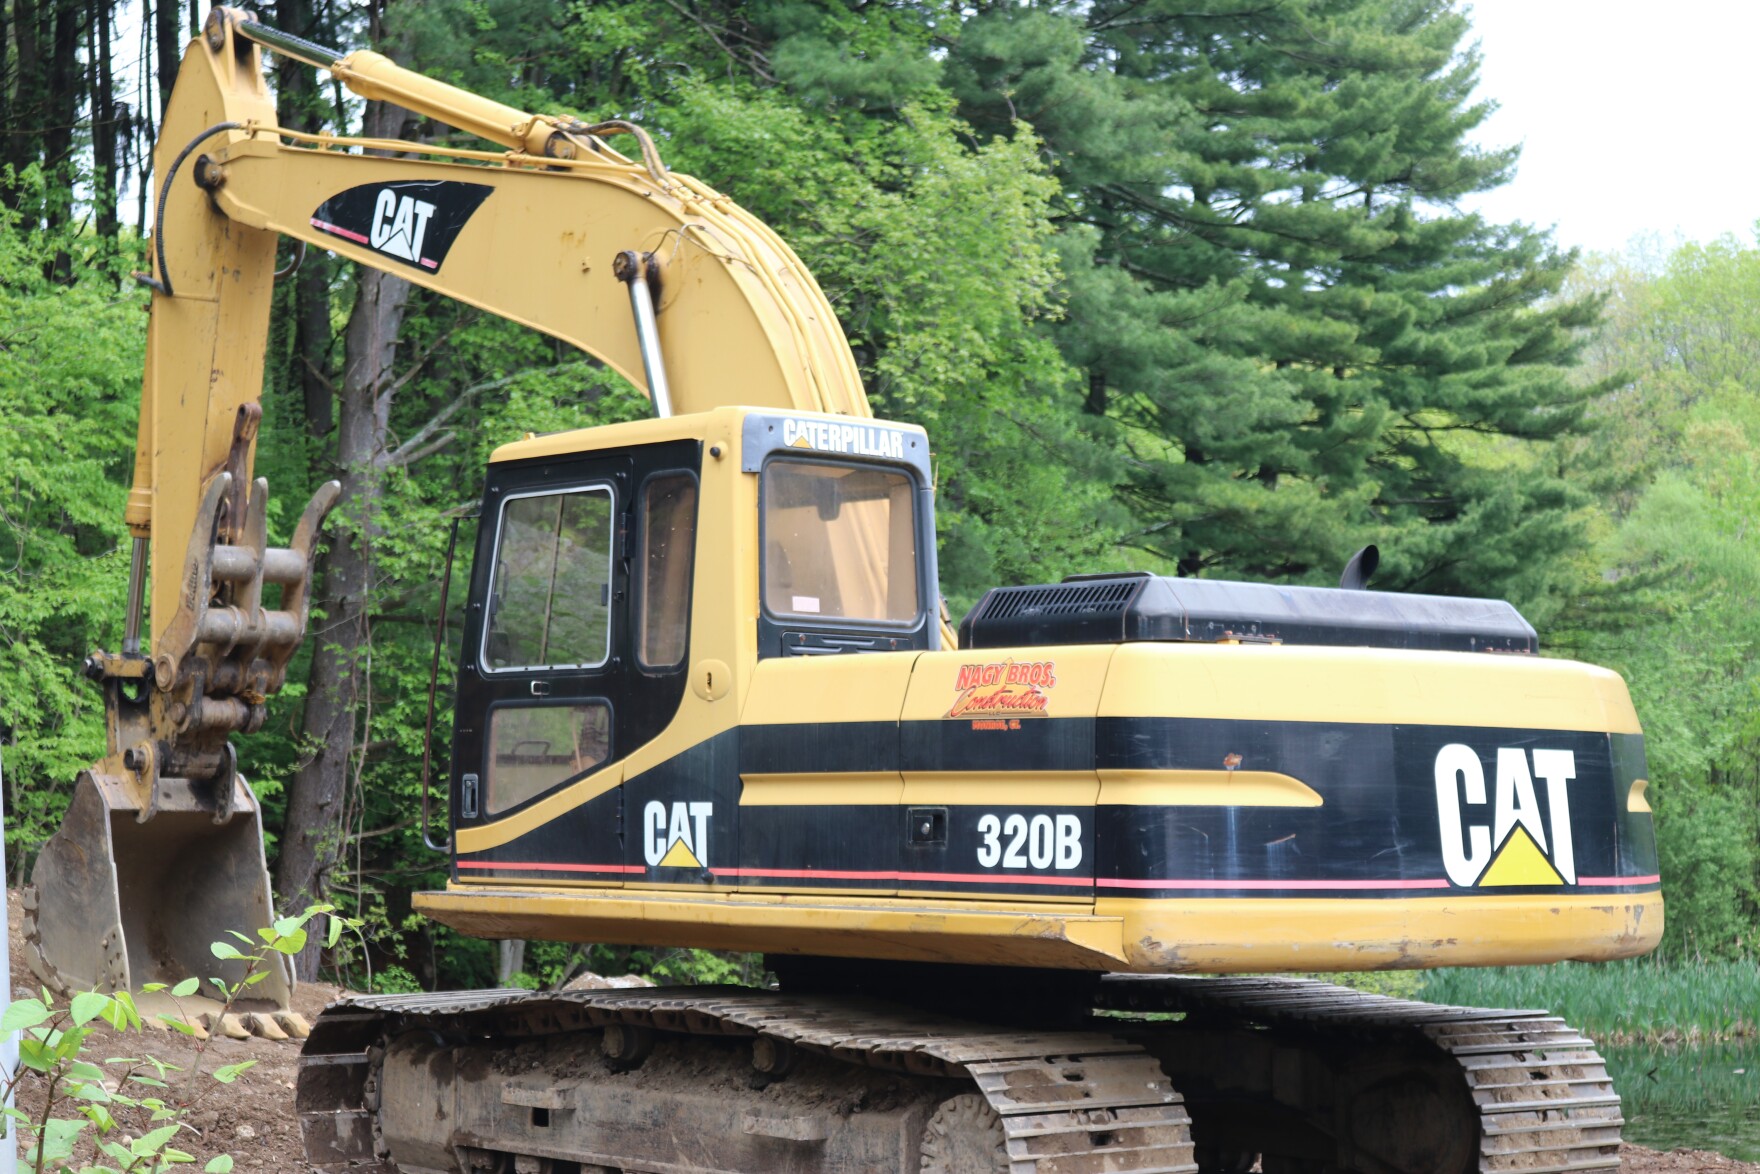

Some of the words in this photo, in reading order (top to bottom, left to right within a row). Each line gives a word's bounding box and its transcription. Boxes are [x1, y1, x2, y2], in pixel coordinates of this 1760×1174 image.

[370, 188, 436, 263] CAT
[783, 418, 904, 459] CATERPILLAR
[951, 685, 1048, 717] Construction
[955, 664, 1006, 691] NAGY
[1005, 662, 1056, 688] BROS.
[644, 800, 713, 867] CAT
[977, 813, 1083, 870] 320B
[1434, 743, 1576, 887] CAT
